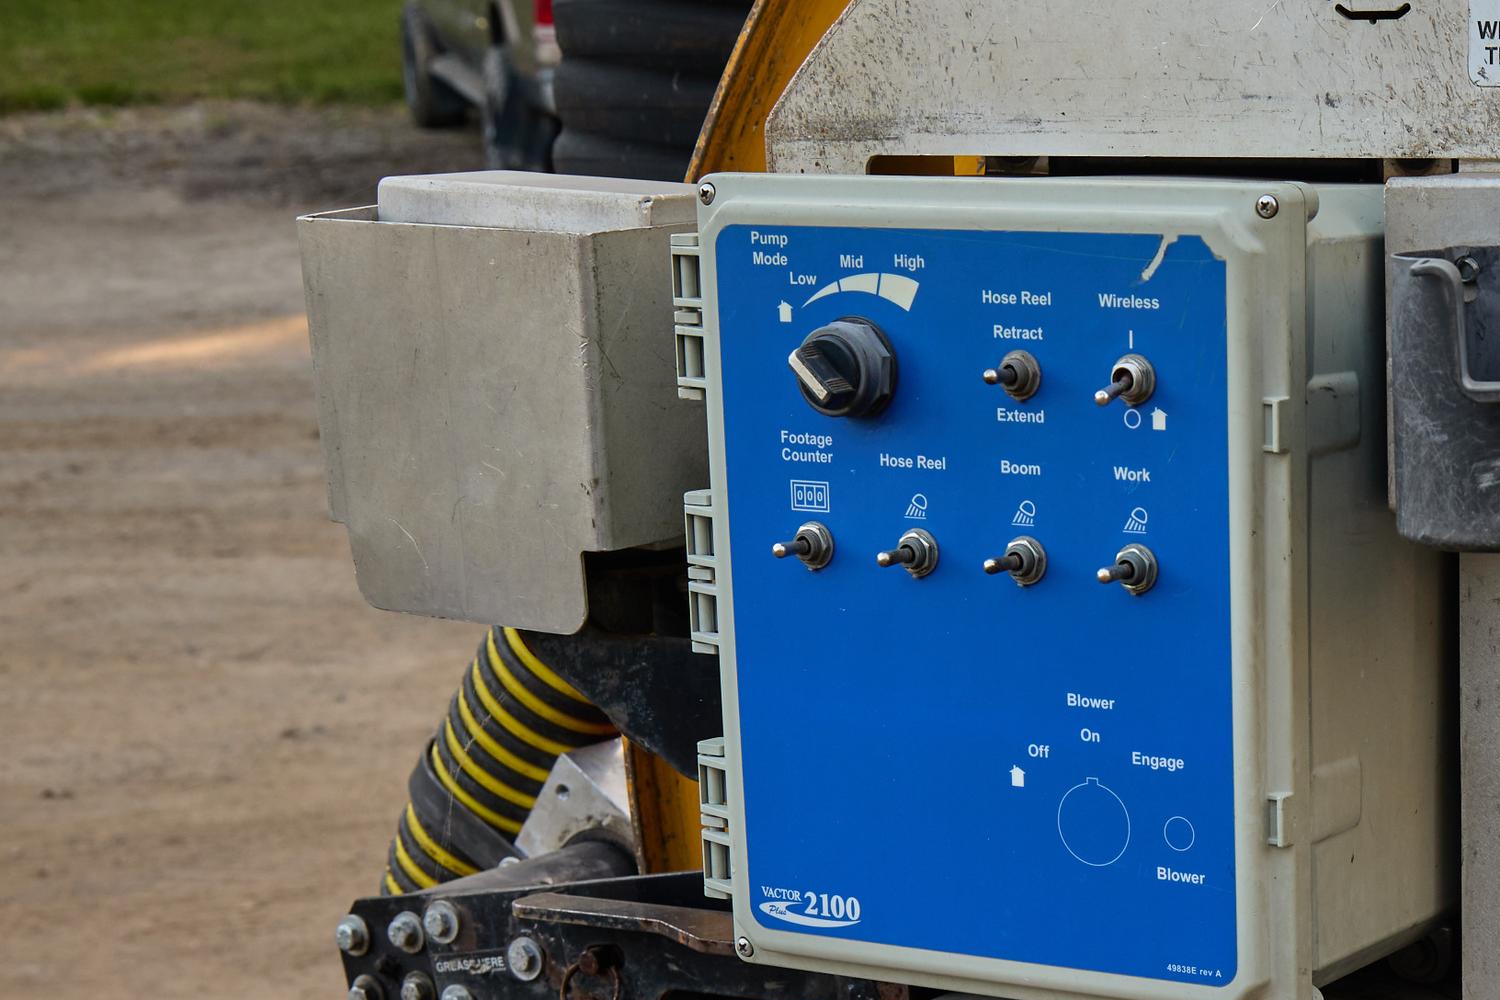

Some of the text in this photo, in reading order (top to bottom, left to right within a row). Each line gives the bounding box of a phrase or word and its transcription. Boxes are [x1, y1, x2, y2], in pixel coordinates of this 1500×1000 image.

[751, 231, 788, 248] Pump
[753, 251, 788, 266] Mode
[840, 254, 863, 268] Mid
[894, 254, 925, 271] High
[790, 271, 817, 285] Low
[982, 290, 1051, 306] Hose Reel
[1098, 293, 1160, 309] Wireless
[993, 325, 1043, 340] Retract
[997, 408, 1044, 423] Extend
[781, 430, 832, 449] Footage
[782, 447, 833, 463] Counter
[880, 453, 946, 470] Hose Reel
[1001, 460, 1041, 475] Boom
[1113, 466, 1150, 482] Work
[1067, 693, 1115, 709] Blower
[1080, 728, 1100, 742] On
[1028, 744, 1049, 758] Off
[1132, 751, 1184, 772] Engage
[1157, 866, 1205, 884] Blower
[761, 886, 860, 920] VACTOR 2100
[769, 905, 787, 917] Plus
[1167, 964, 1197, 975] 49838E
[1215, 970, 1222, 978] A
